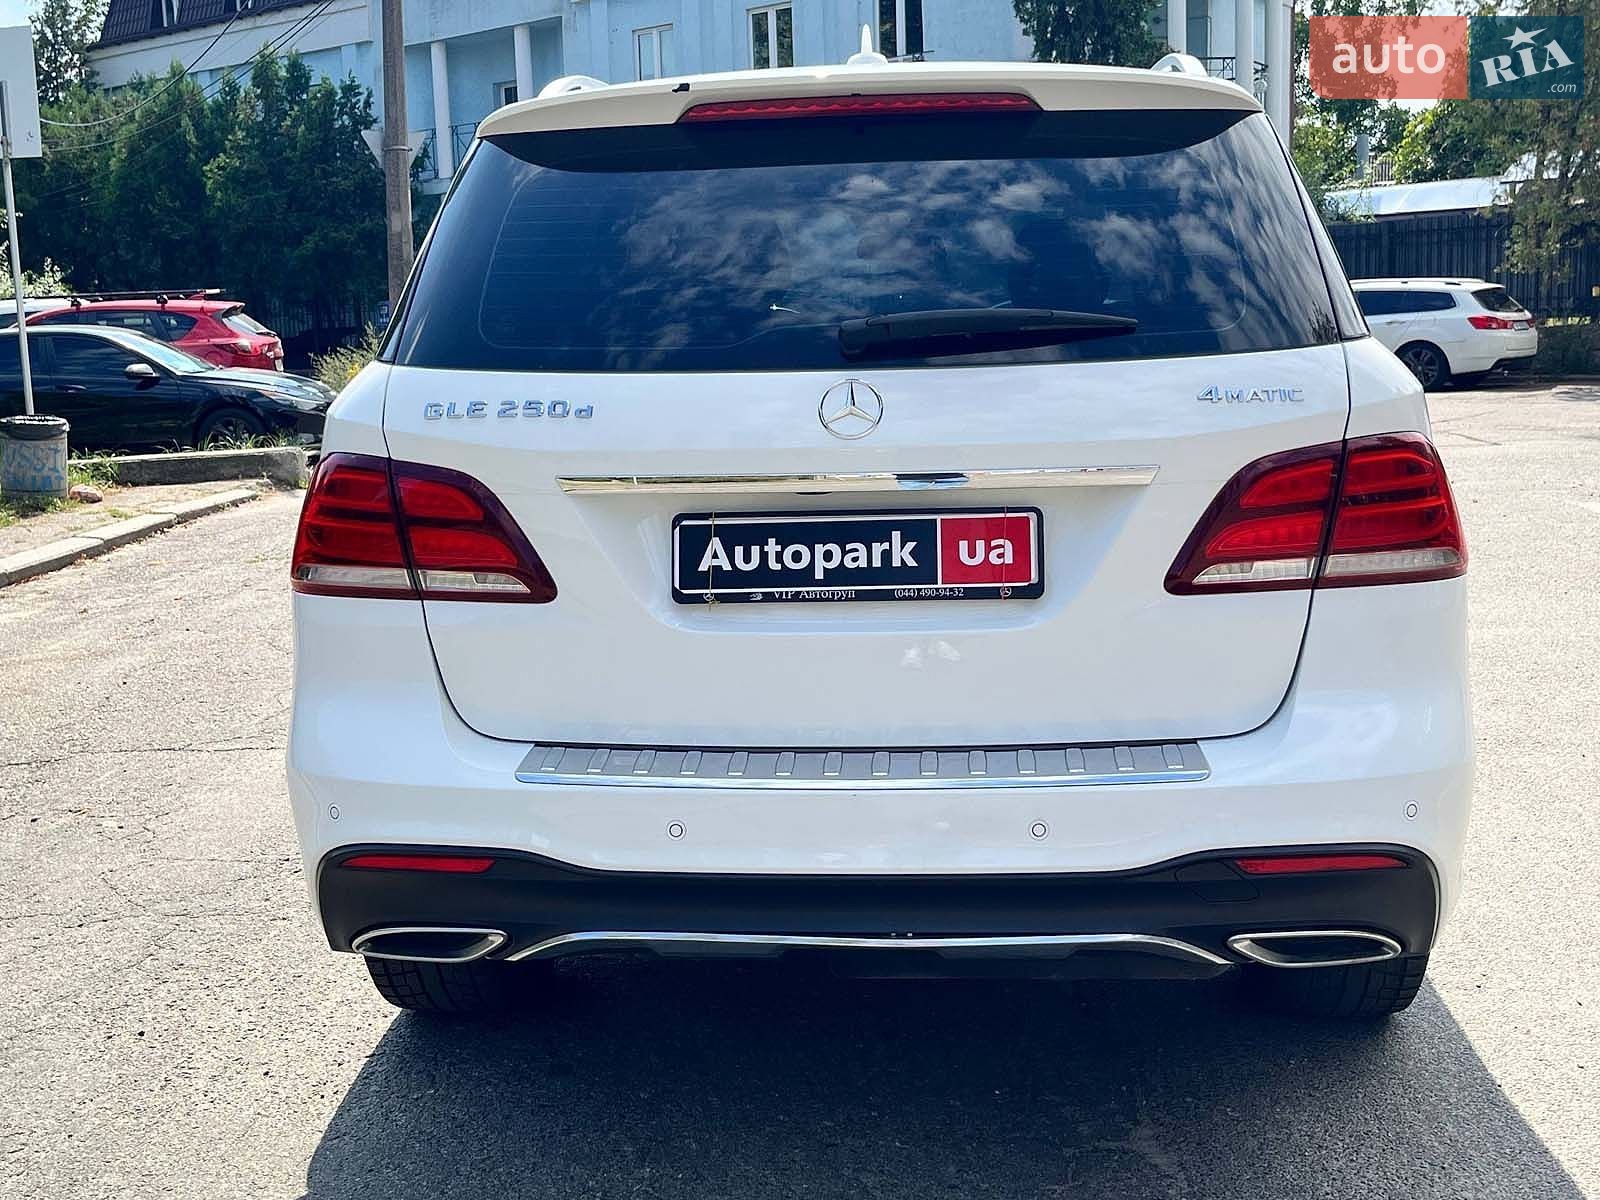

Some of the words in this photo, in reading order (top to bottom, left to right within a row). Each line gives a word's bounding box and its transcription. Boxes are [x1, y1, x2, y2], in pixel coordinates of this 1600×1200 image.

[423, 400, 489, 420] GLE
[497, 400, 594, 419] 250d
[697, 530, 919, 580] Autopark
[957, 537, 1014, 565] ua
[774, 590, 796, 599] VIP
[894, 587, 918, 598] (044)
[920, 587, 965, 597] 490-94-32
